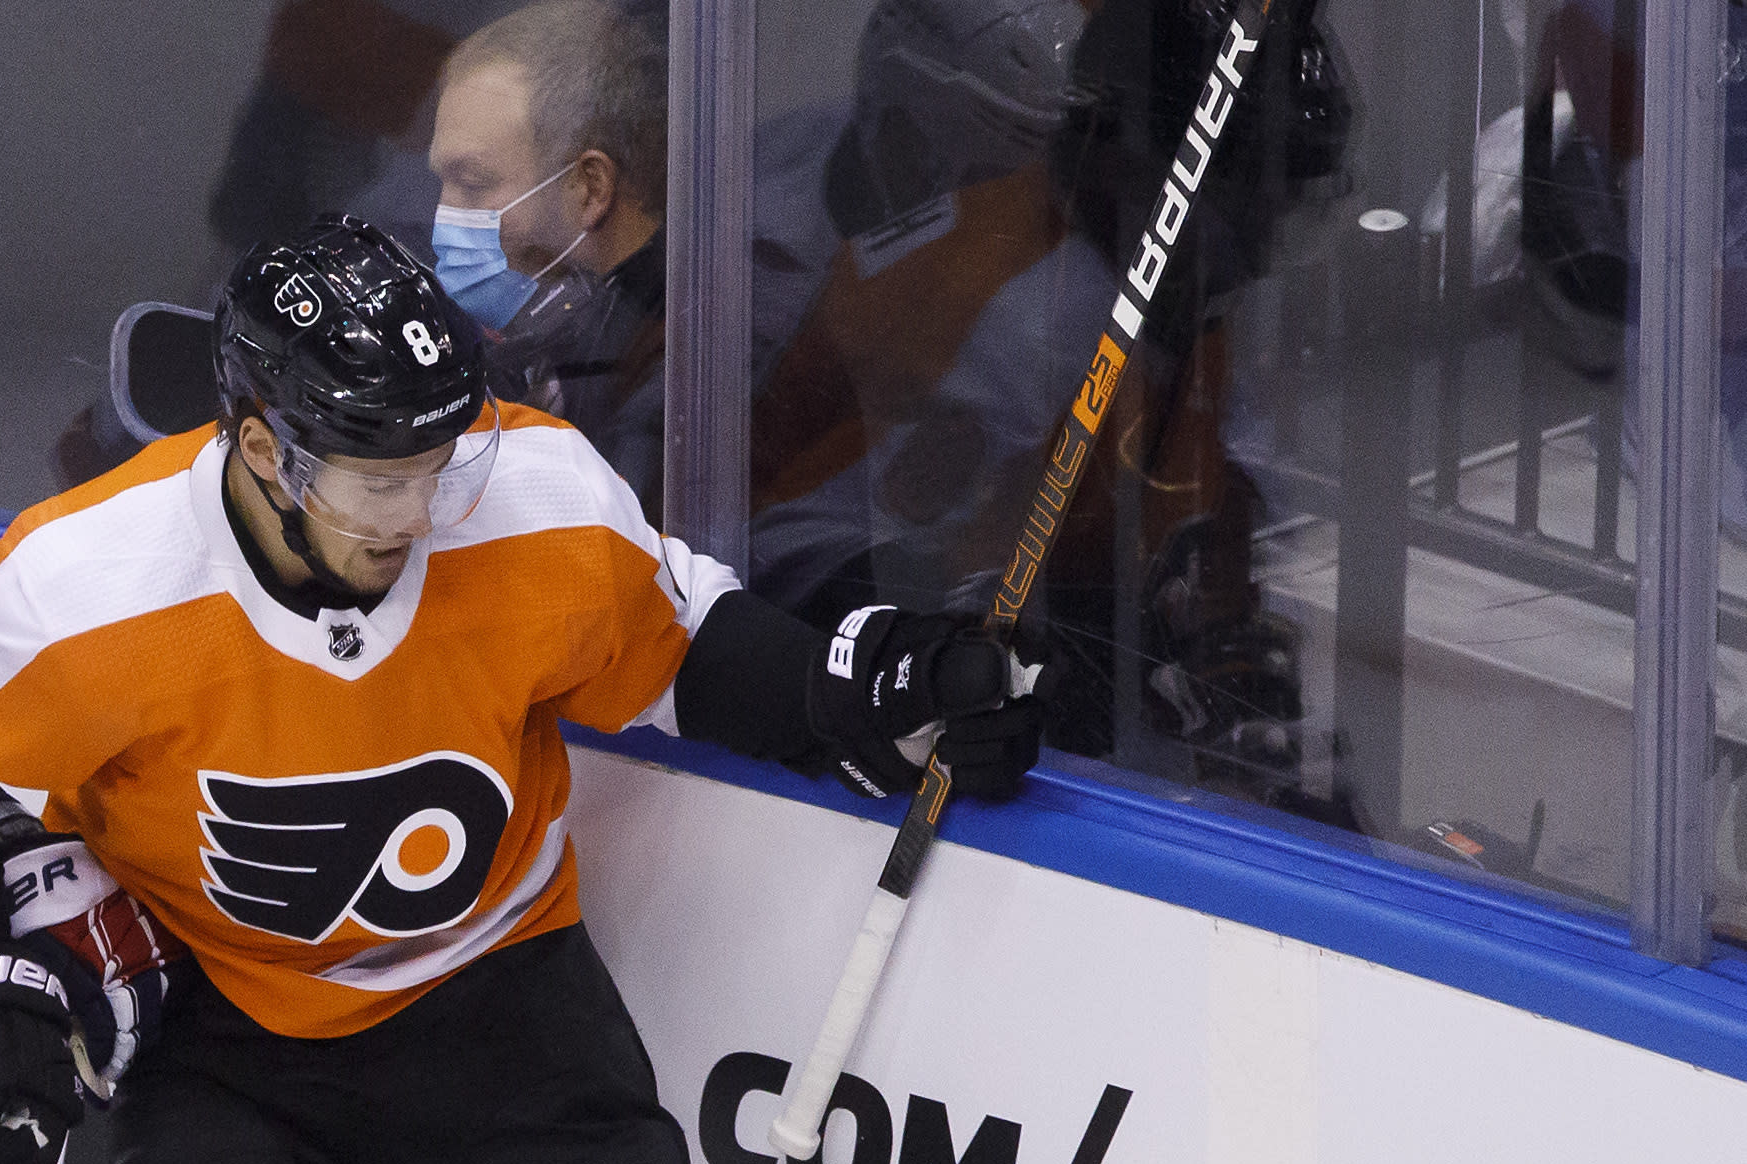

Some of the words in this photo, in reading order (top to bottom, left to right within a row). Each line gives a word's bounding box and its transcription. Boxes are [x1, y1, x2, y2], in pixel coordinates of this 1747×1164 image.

[1128, 18, 1258, 302] BAUER
[403, 320, 440, 366] 8
[412, 393, 470, 427] BAUER
